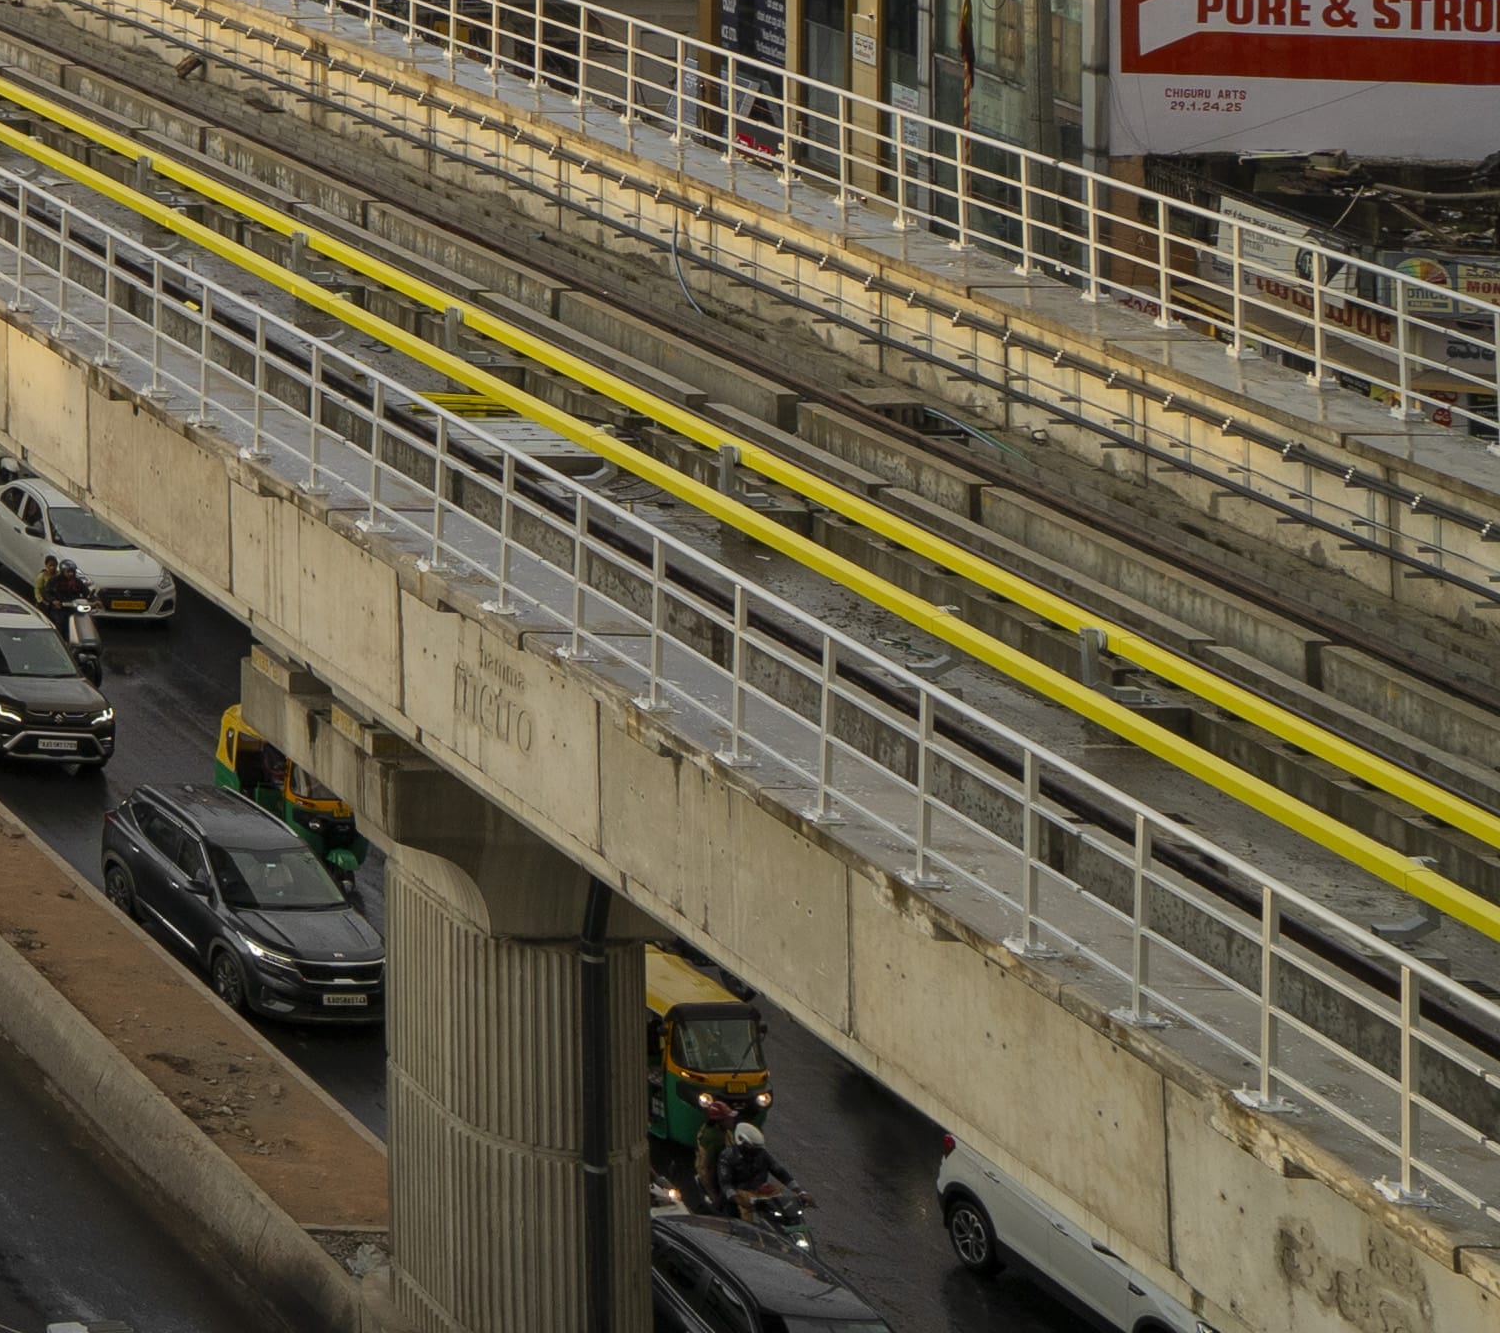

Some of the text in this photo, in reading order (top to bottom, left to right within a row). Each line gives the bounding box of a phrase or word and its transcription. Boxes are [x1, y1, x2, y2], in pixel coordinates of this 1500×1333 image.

[1164, 87, 1247, 100] CHIGURU ARTS
[1170, 101, 1242, 112] 29.1.24.25
